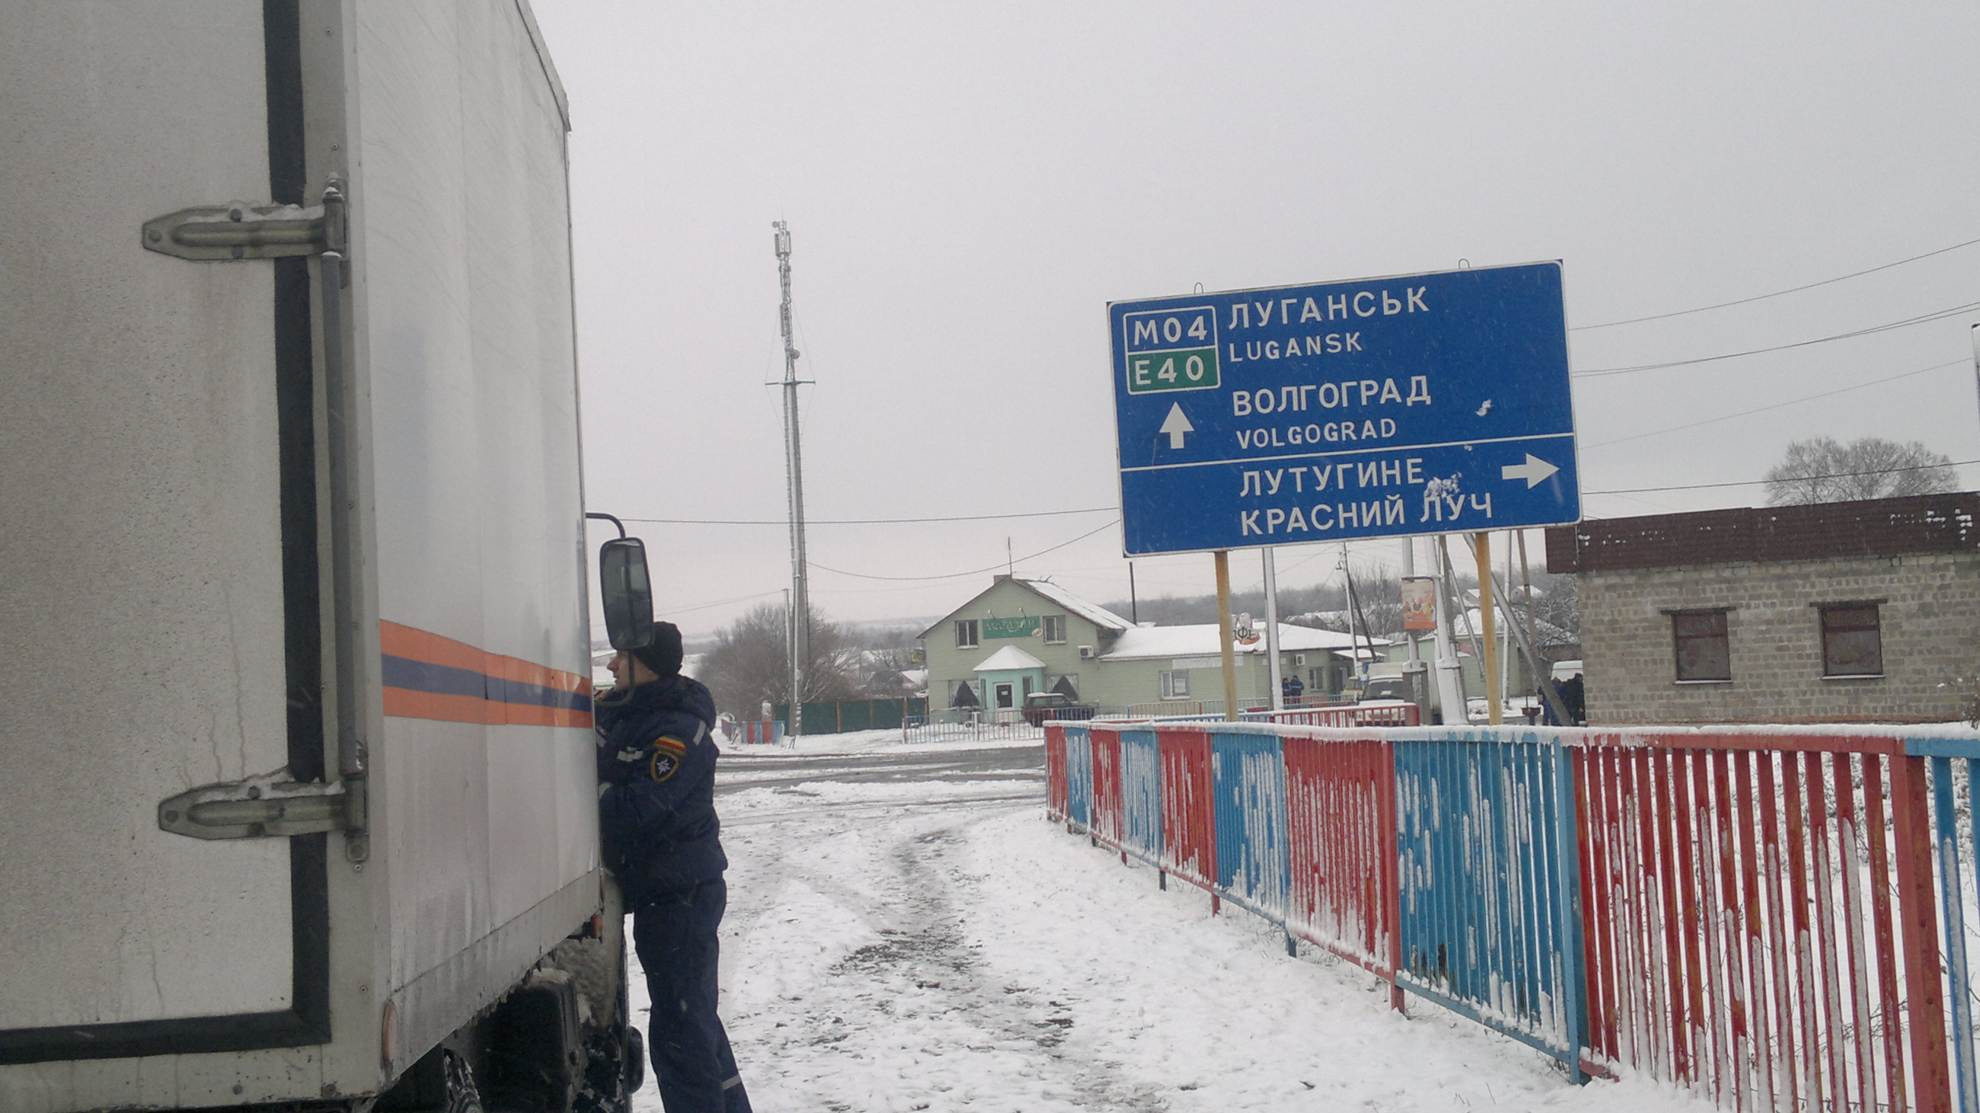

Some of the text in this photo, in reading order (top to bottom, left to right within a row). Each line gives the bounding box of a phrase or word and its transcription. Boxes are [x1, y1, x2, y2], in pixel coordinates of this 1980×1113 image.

[1228, 286, 1429, 330] ЛУГАНСЬК
[1229, 331, 1362, 362] LUGANSK
[1134, 355, 1205, 386] E40
[1232, 375, 1432, 417] ВОЛГОГРАД
[1236, 418, 1396, 450] VOLGOGRAD
[1240, 457, 1425, 497] ЛУТУГИНЕ
[1241, 492, 1492, 537] КРАСНИЙ ЛУЧ
